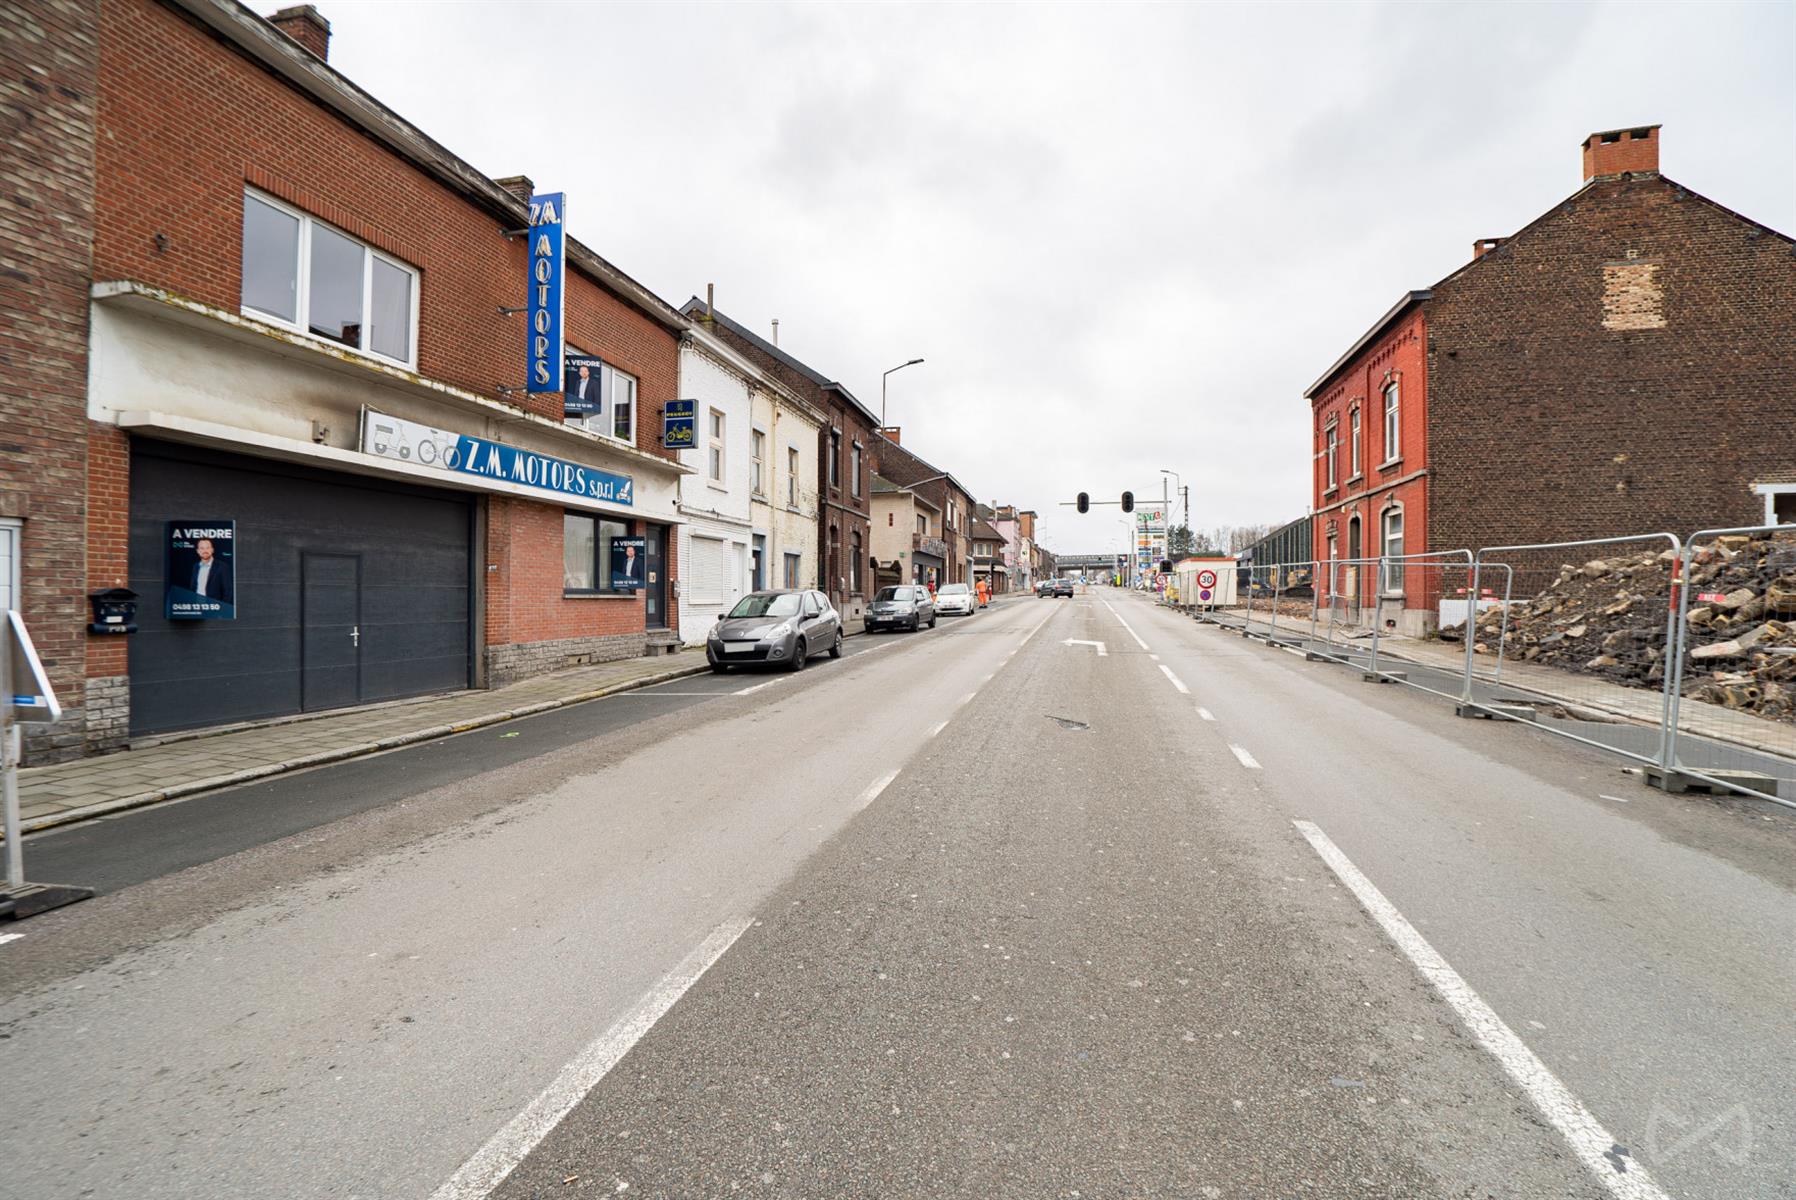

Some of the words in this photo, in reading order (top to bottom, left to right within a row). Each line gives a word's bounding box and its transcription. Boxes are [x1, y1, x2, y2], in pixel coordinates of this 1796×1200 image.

[534, 234, 552, 386] MOTORS
[465, 440, 506, 478] Z.M.
[511, 452, 586, 495] MOTORS
[172, 528, 183, 539] A
[184, 528, 233, 539] VENDRE
[1200, 575, 1213, 584] 30
